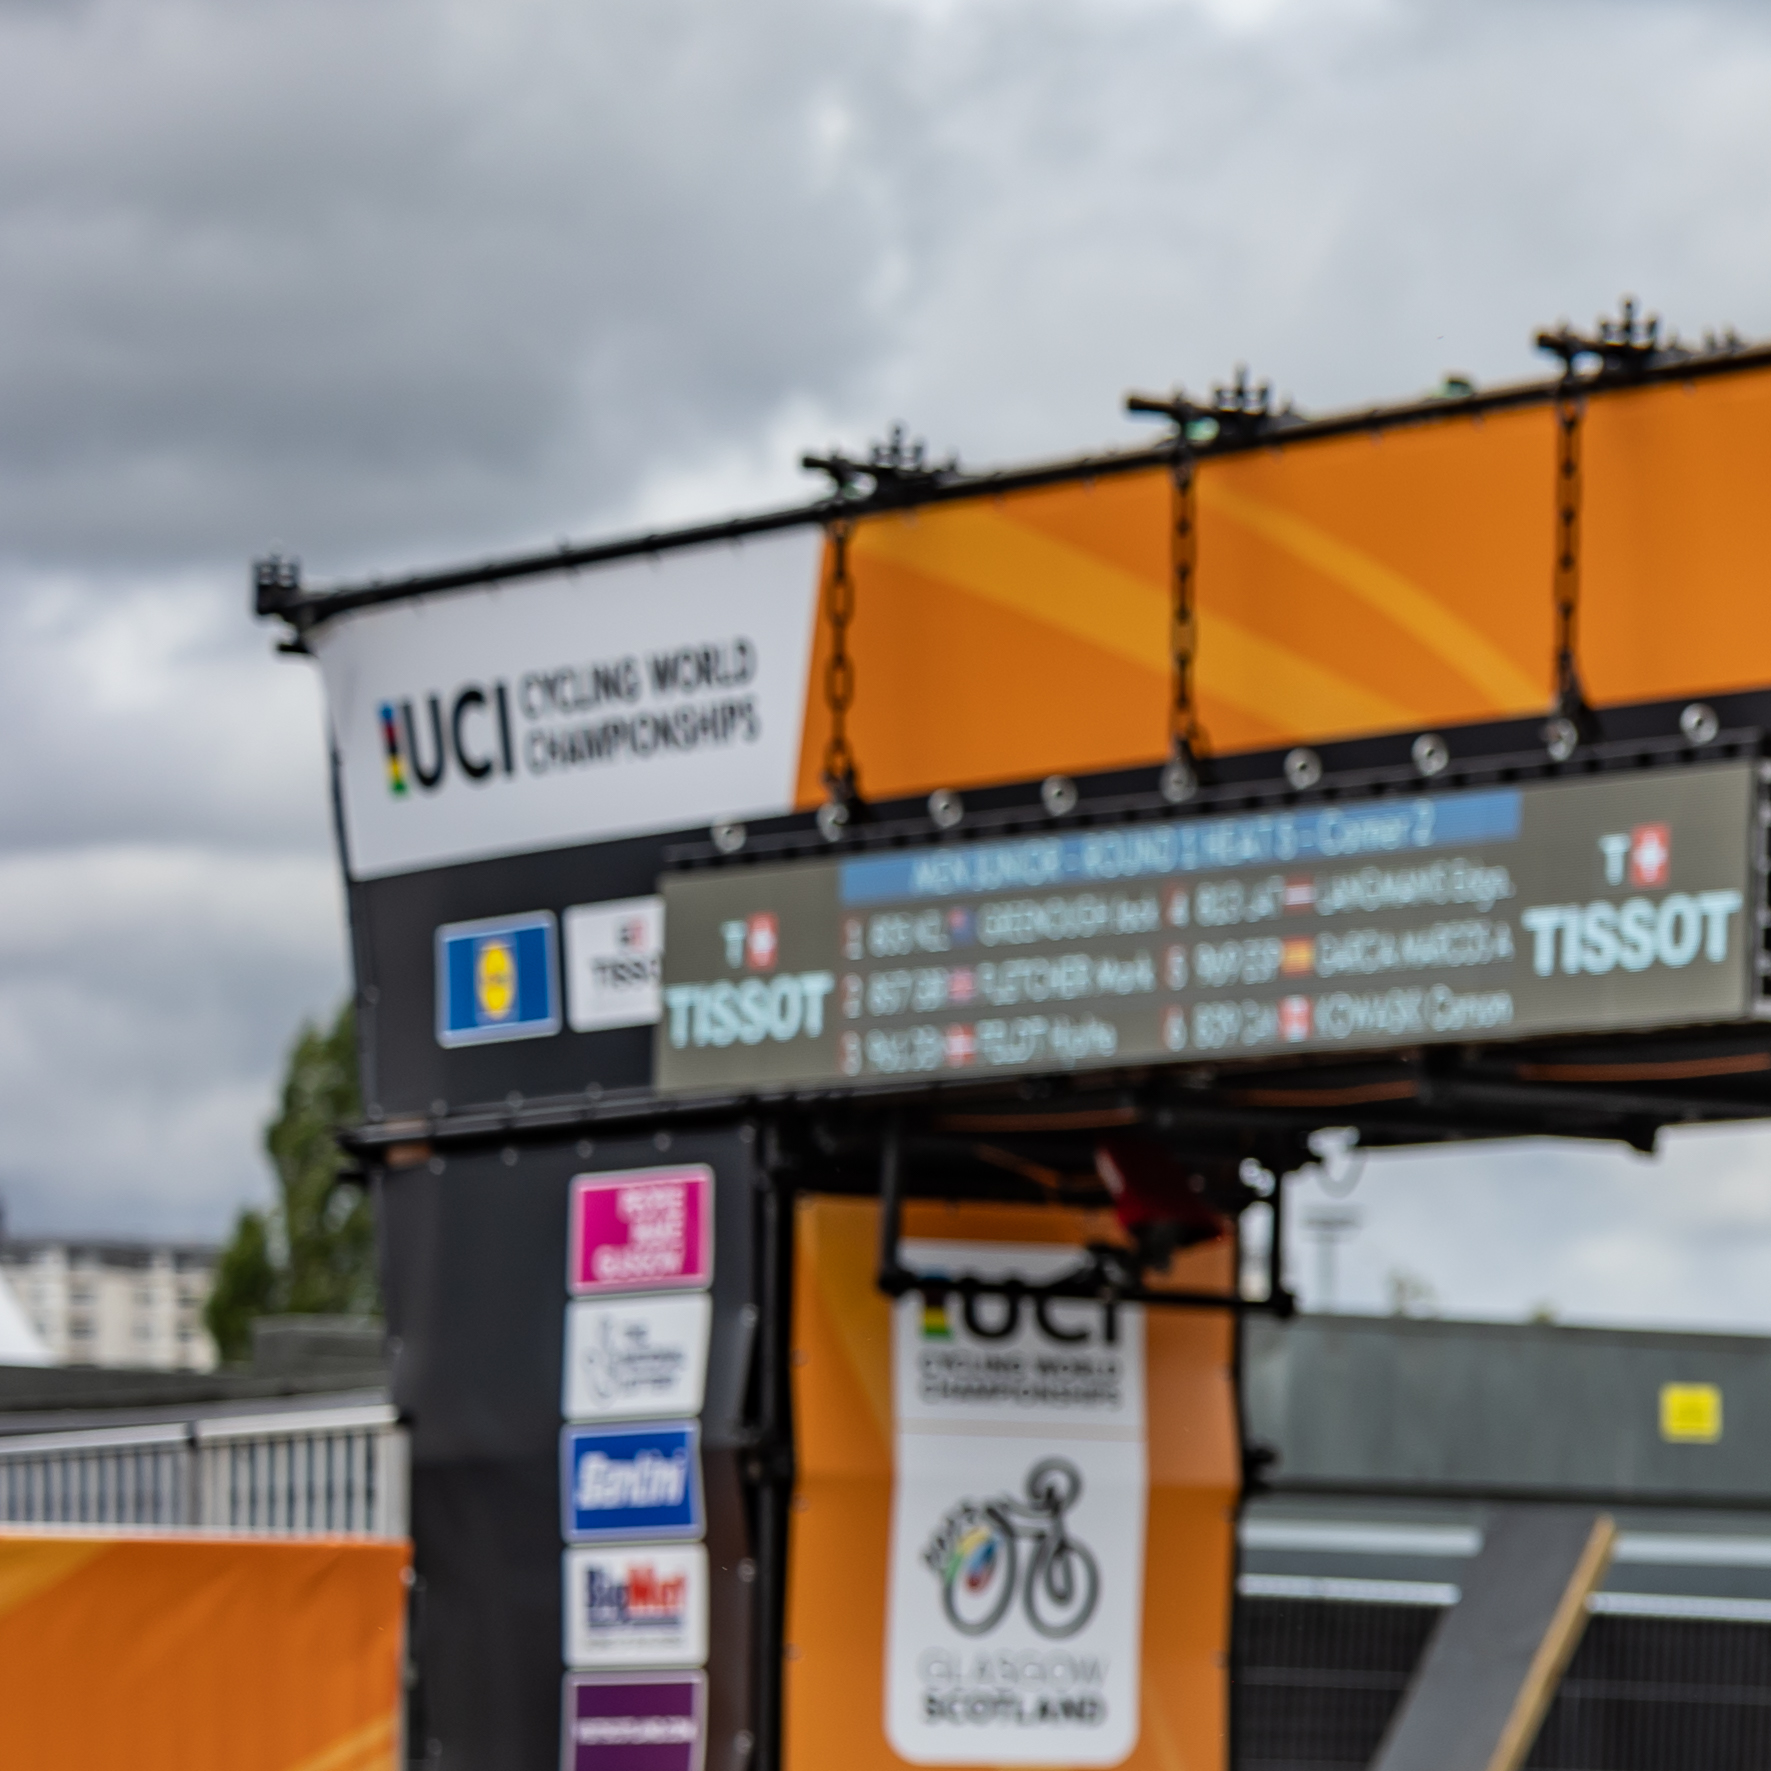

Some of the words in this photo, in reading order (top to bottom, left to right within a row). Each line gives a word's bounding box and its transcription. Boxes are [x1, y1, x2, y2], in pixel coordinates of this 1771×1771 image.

[402, 678, 516, 789] UCI
[519, 652, 644, 719] CYCLING
[648, 633, 759, 693] WORLD
[522, 693, 763, 777] CHAMPIONSHIPS
[1521, 890, 1744, 978] TISSOT
[664, 969, 836, 1050] TISSOT
[916, 1648, 1110, 1692] GLASGOW
[920, 1689, 1109, 1729] SCOTLAND
